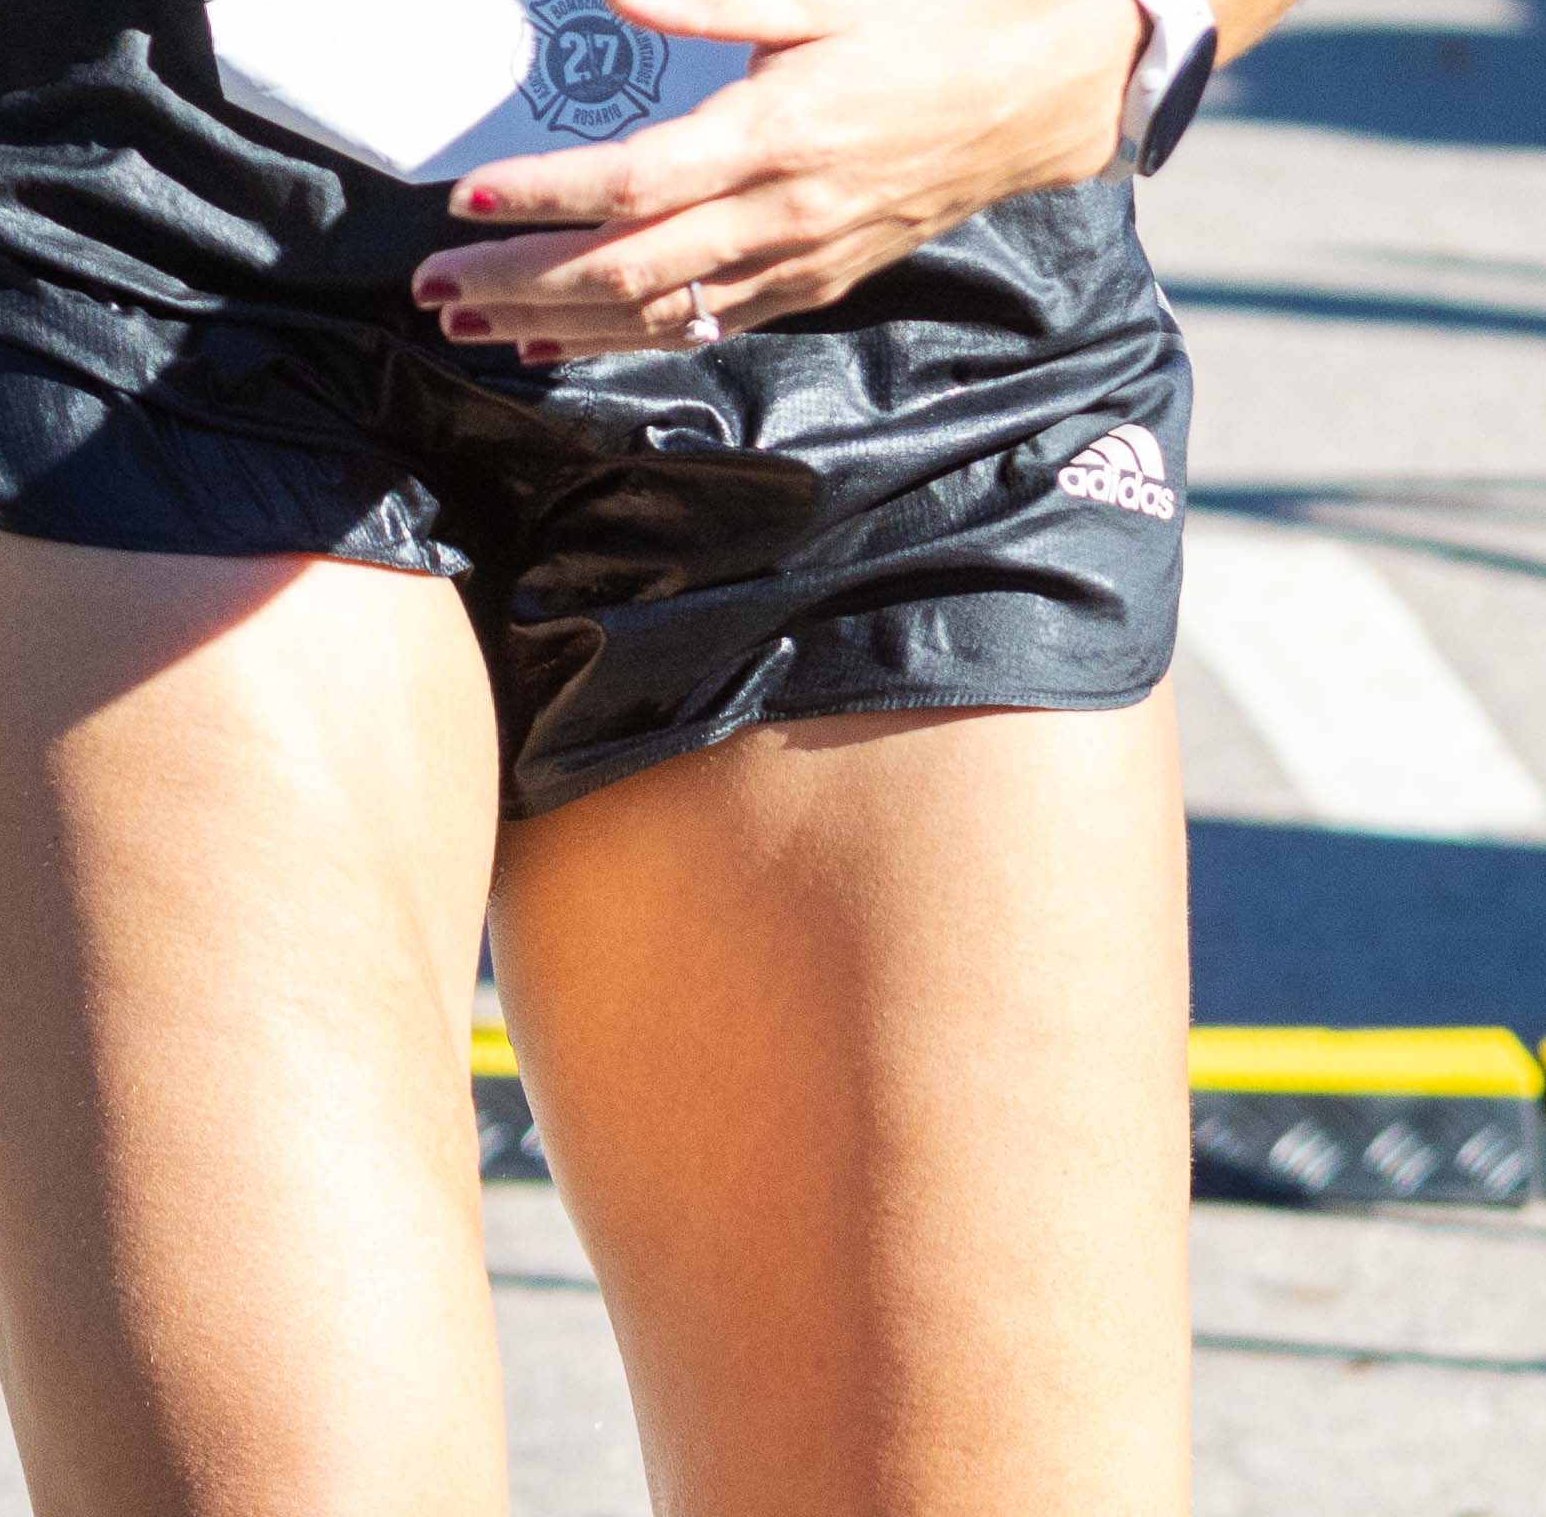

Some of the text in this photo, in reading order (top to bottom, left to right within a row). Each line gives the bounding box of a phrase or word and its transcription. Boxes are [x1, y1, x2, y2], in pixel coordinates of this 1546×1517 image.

[559, 31, 619, 86] 27
[573, 103, 623, 126] ROSARIO
[1057, 463, 1175, 521] adidas
